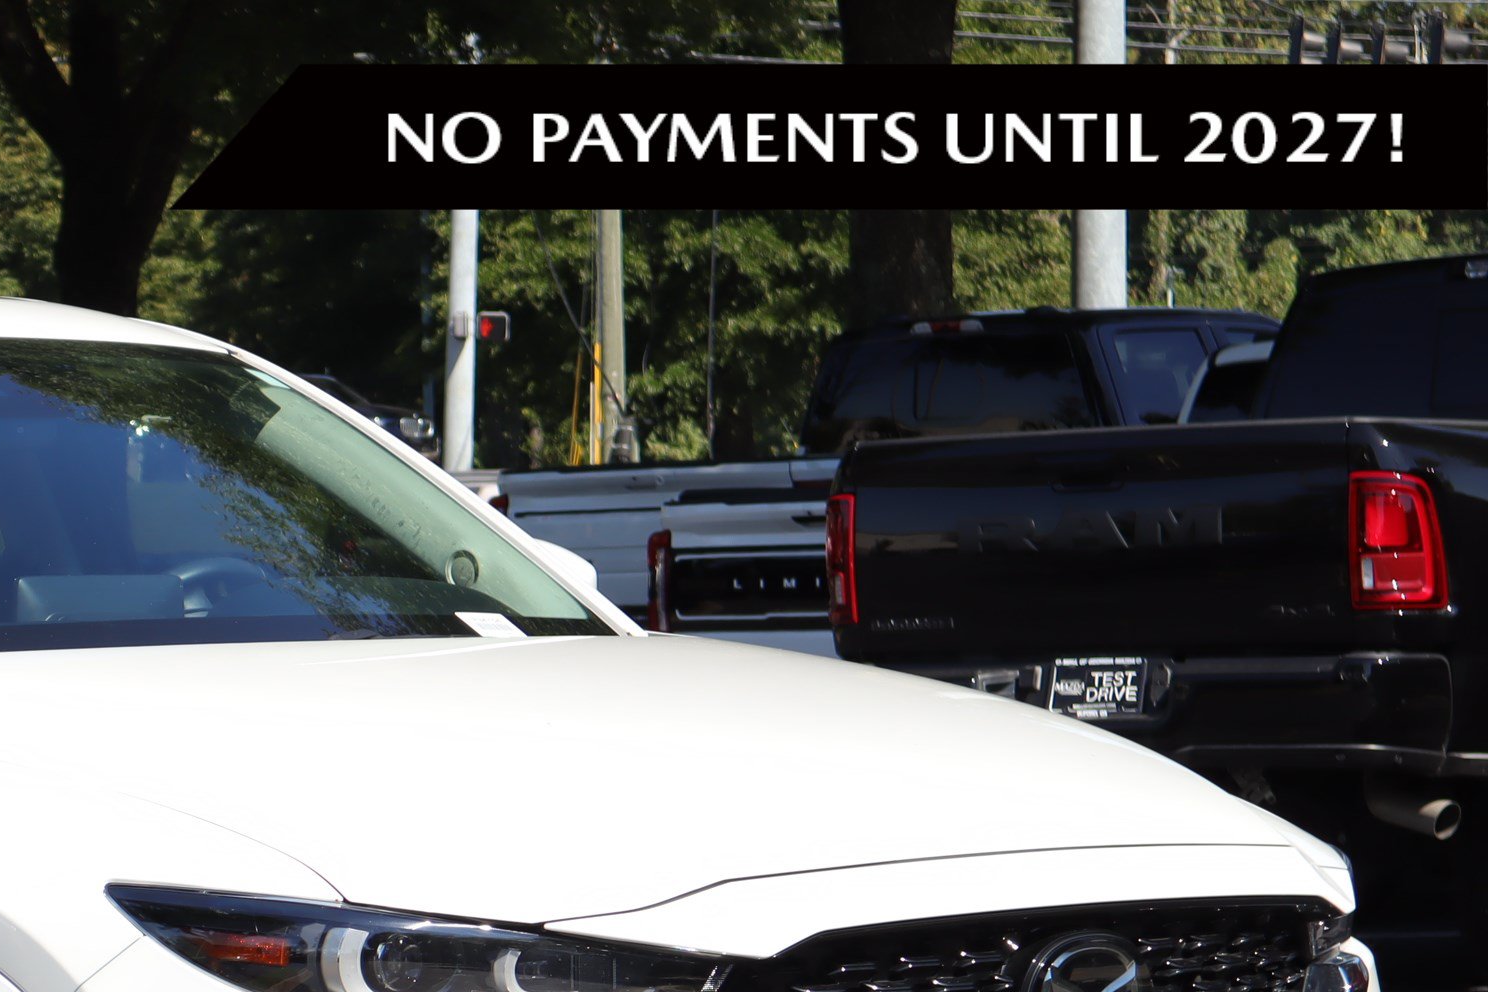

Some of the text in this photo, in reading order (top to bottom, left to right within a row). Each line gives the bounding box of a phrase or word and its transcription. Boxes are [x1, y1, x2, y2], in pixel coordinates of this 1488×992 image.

[957, 504, 1225, 553] RAM
[732, 576, 821, 590] LIMI
[1090, 671, 1137, 688] TEST
[1086, 685, 1139, 703] DRIVE
